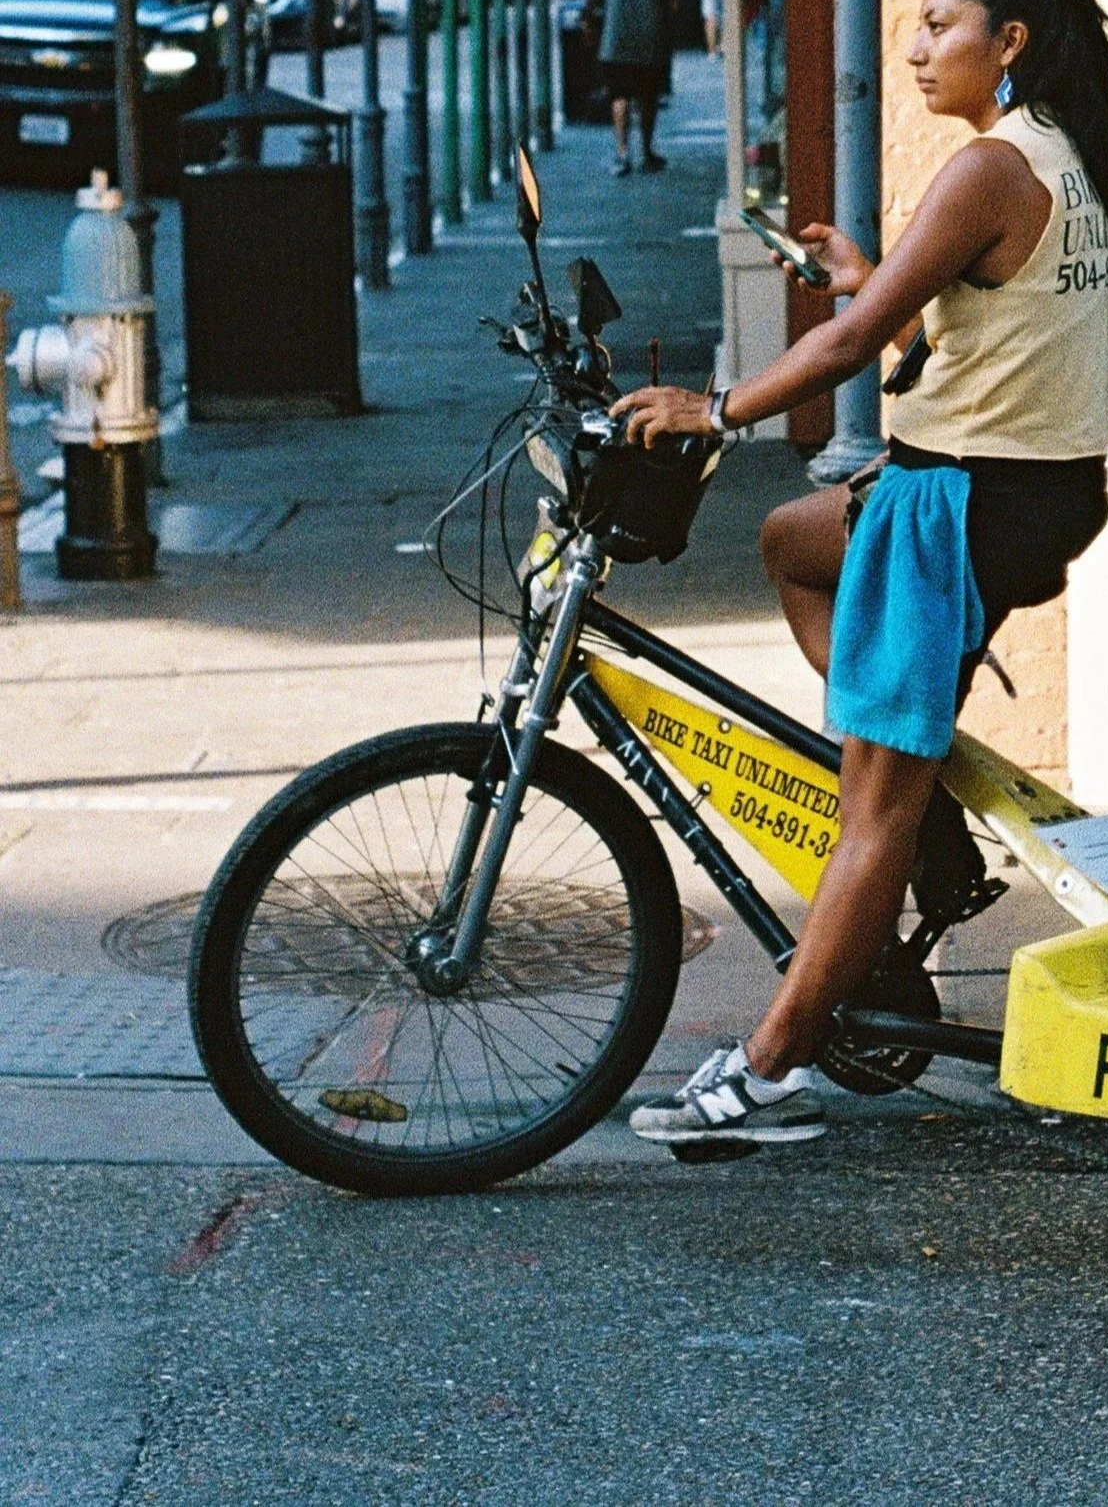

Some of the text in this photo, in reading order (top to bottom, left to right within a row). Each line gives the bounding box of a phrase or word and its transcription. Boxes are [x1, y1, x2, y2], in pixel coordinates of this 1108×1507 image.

[643, 708, 688, 748] BIKE
[691, 731, 735, 770] TAXI
[730, 791, 835, 859] 504-891-3
